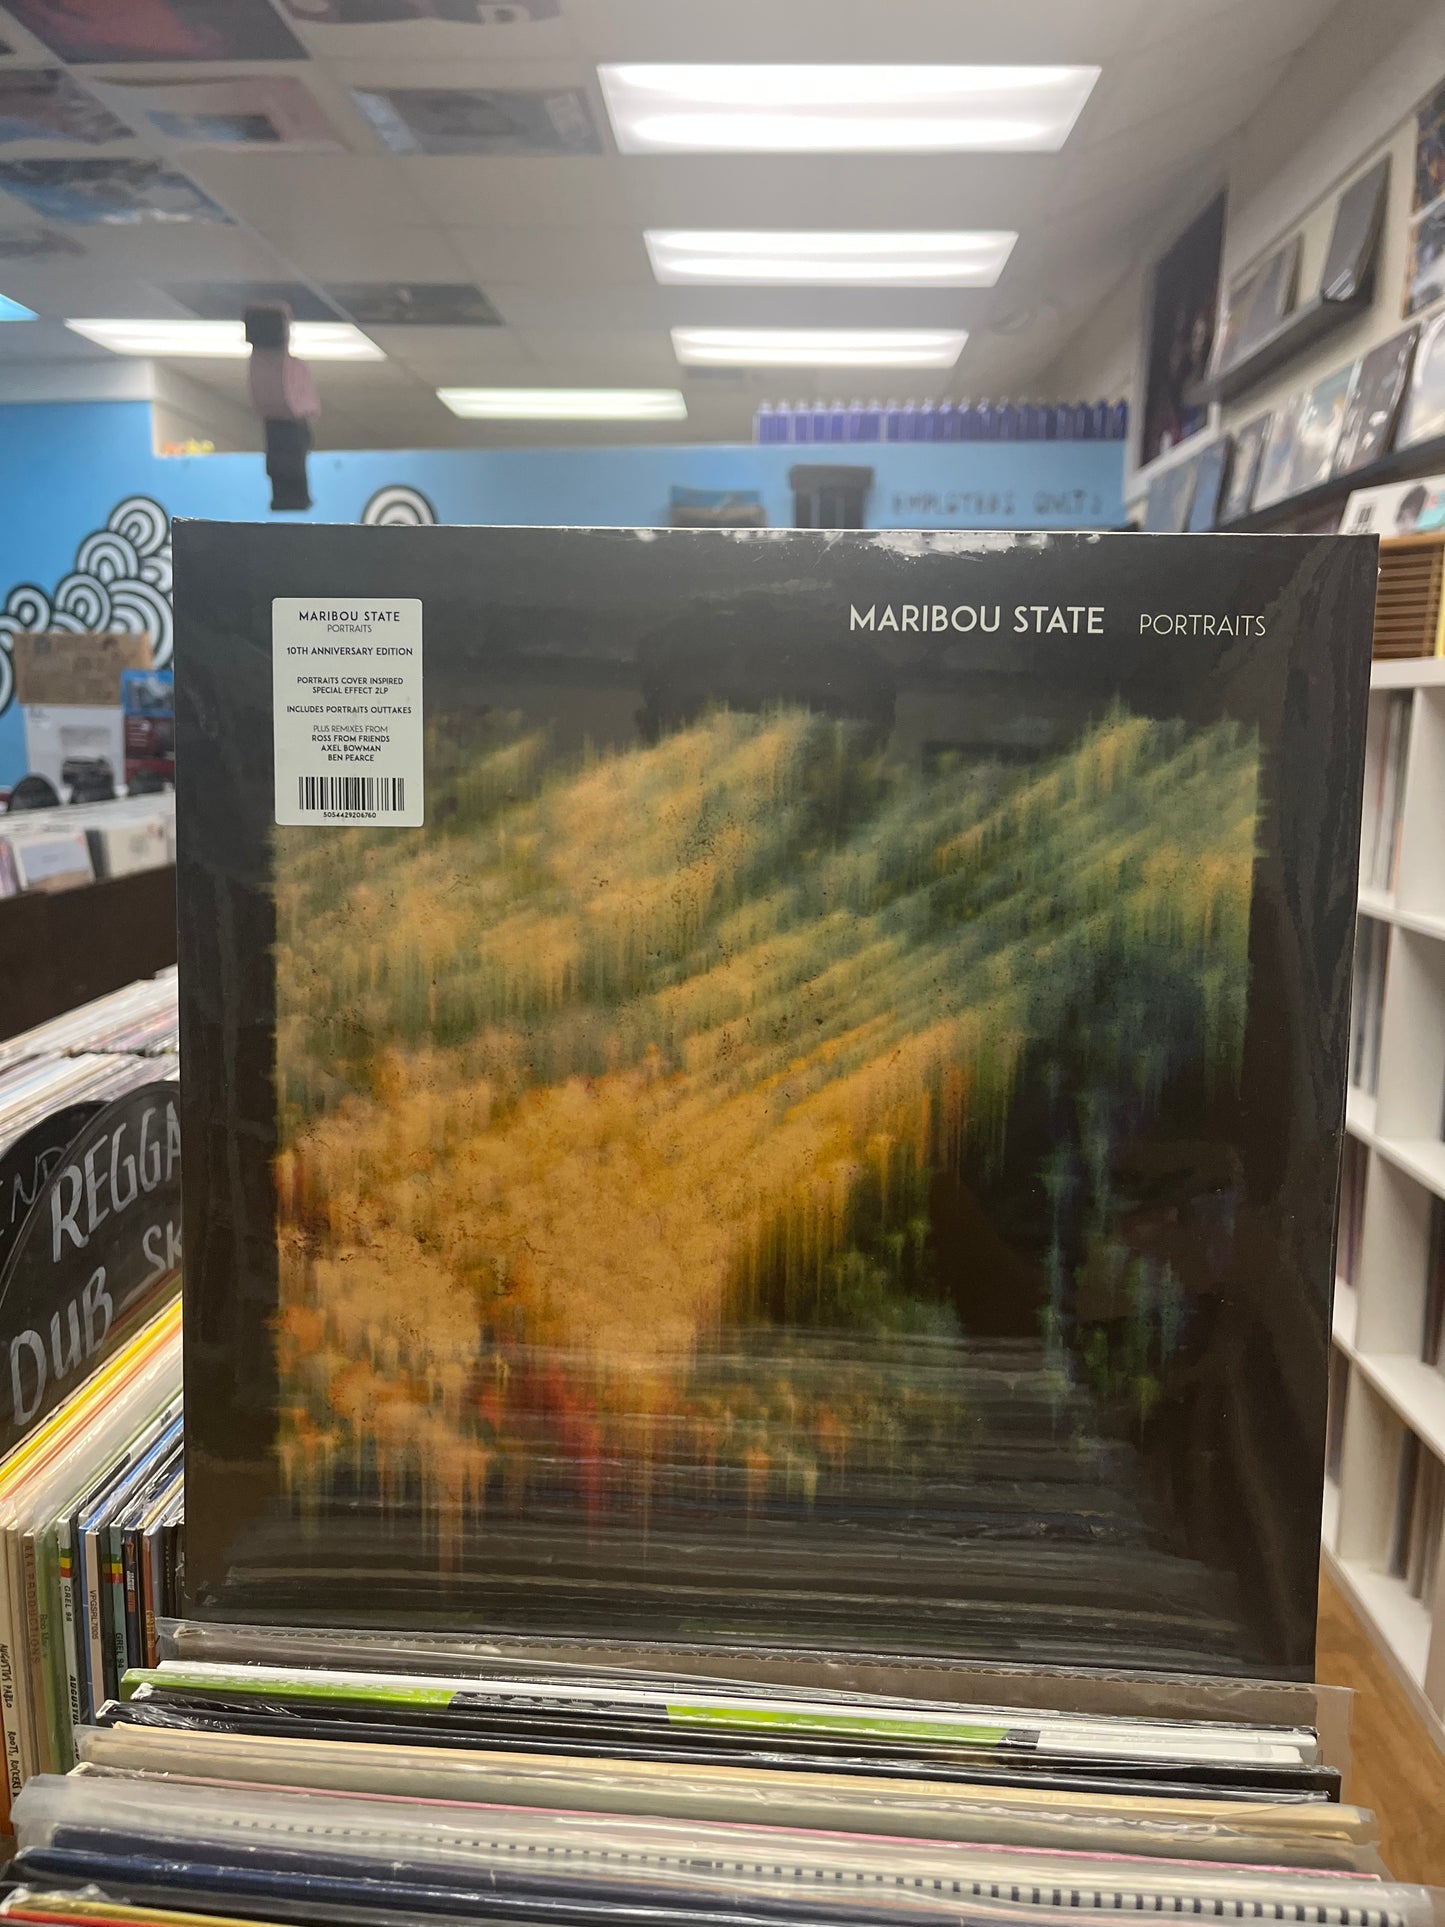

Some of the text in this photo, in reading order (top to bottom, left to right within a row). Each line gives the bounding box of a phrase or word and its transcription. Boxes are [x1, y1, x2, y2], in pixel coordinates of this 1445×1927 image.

[299, 611, 400, 622] MARIBOU STATE
[849, 604, 1267, 637] MARIBOU STATE PORTRAITS
[327, 624, 372, 633] PORTRAITS
[287, 647, 413, 656] 10TH ANNIVERSARY EDITION
[297, 677, 404, 685] PORTRAITS COVER INSPIRED
[344, 687, 372, 695] EFFECT
[374, 687, 389, 695] 2LP
[286, 705, 412, 714] INCLUDES PORTRAITS OUTTAKES
[331, 725, 363, 733] REMIXES
[358, 735, 390, 743] FRIENDS
[345, 754, 375, 762] PEARCE
[10, 1266, 113, 1426] DUB
[64, 1585, 73, 1609] GREL
[115, 1632, 124, 1656] GREL
[3, 1684, 14, 1709] PABLO
[69, 1675, 81, 1725] AUGUSTUS
[10, 1759, 22, 1789] ROCKERS
